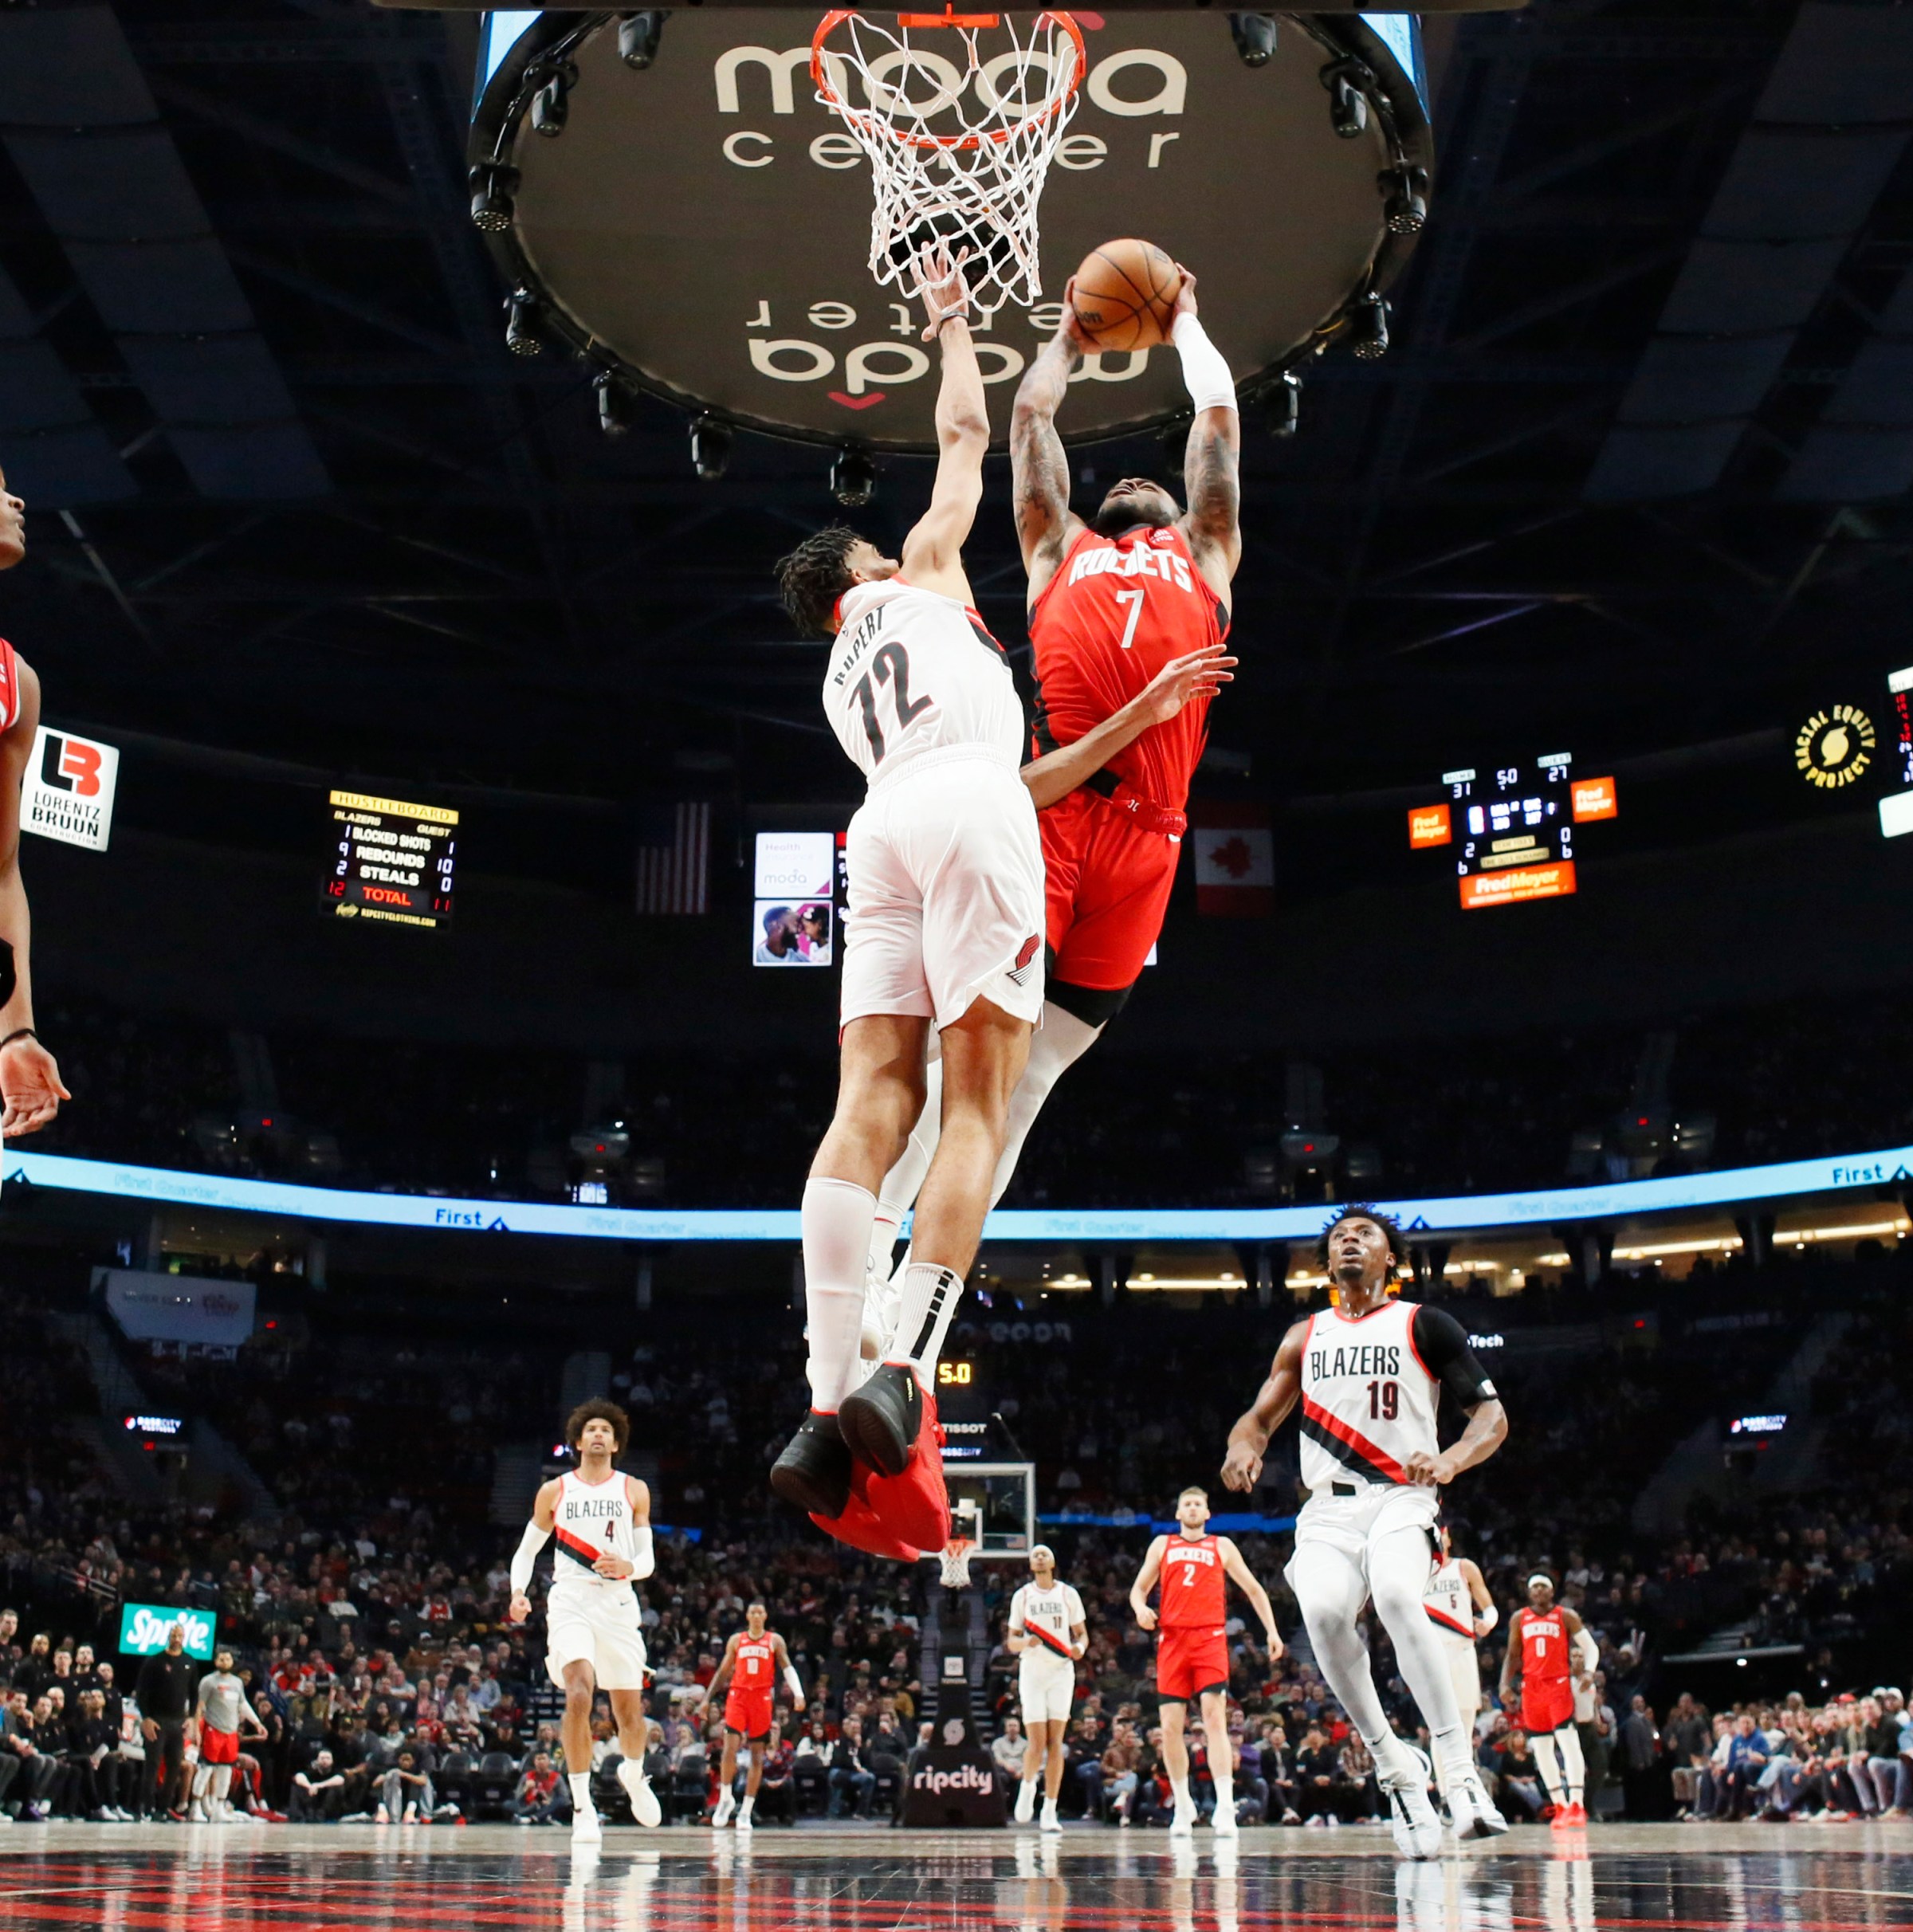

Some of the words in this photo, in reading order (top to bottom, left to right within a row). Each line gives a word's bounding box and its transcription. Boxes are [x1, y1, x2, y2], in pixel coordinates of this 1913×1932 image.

[714, 28, 1188, 116] moda
[1116, 589, 1145, 649] 7
[834, 603, 886, 685] RUPERT
[1833, 705, 1876, 748] EQUITY
[1795, 710, 1829, 770] RACIAL
[1549, 765, 1567, 782] 27
[1805, 752, 1871, 788] PROJECT
[1453, 783, 1471, 798] 31
[34, 791, 100, 822] LORENTZ
[339, 792, 450, 821] HUSTLEBOARD
[32, 807, 99, 838] BRUUN
[334, 811, 381, 826] BLAZERS
[417, 824, 451, 838] GUEST
[1560, 827, 1571, 842] 0
[352, 827, 398, 846] BLOCKED
[399, 834, 431, 851] SHOTS
[1465, 842, 1475, 858] 2
[339, 842, 349, 857] 9
[356, 846, 425, 869] REBOUNDS
[437, 858, 453, 874] 10
[336, 860, 348, 876] 2
[359, 865, 420, 886] STEALS
[441, 877, 452, 893] 0
[764, 873, 807, 884] moda
[328, 881, 346, 897] 12
[363, 886, 412, 906] TOTAL
[1833, 1164, 1883, 1184] First
[436, 1208, 481, 1225] First
[939, 1363, 971, 1384] 5.0
[1310, 1346, 1400, 1381] BLAZERS
[1367, 1380, 1398, 1420] 19
[941, 1423, 987, 1434] TISSOT
[567, 1500, 623, 1520] BLAZERS
[605, 1520, 614, 1543] 4
[1183, 1563, 1196, 1586] 2
[1451, 1594, 1456, 1609] 5
[126, 1608, 210, 1653] Sprite
[1535, 1637, 1546, 1657] 0
[914, 1764, 993, 1795] ripcity
